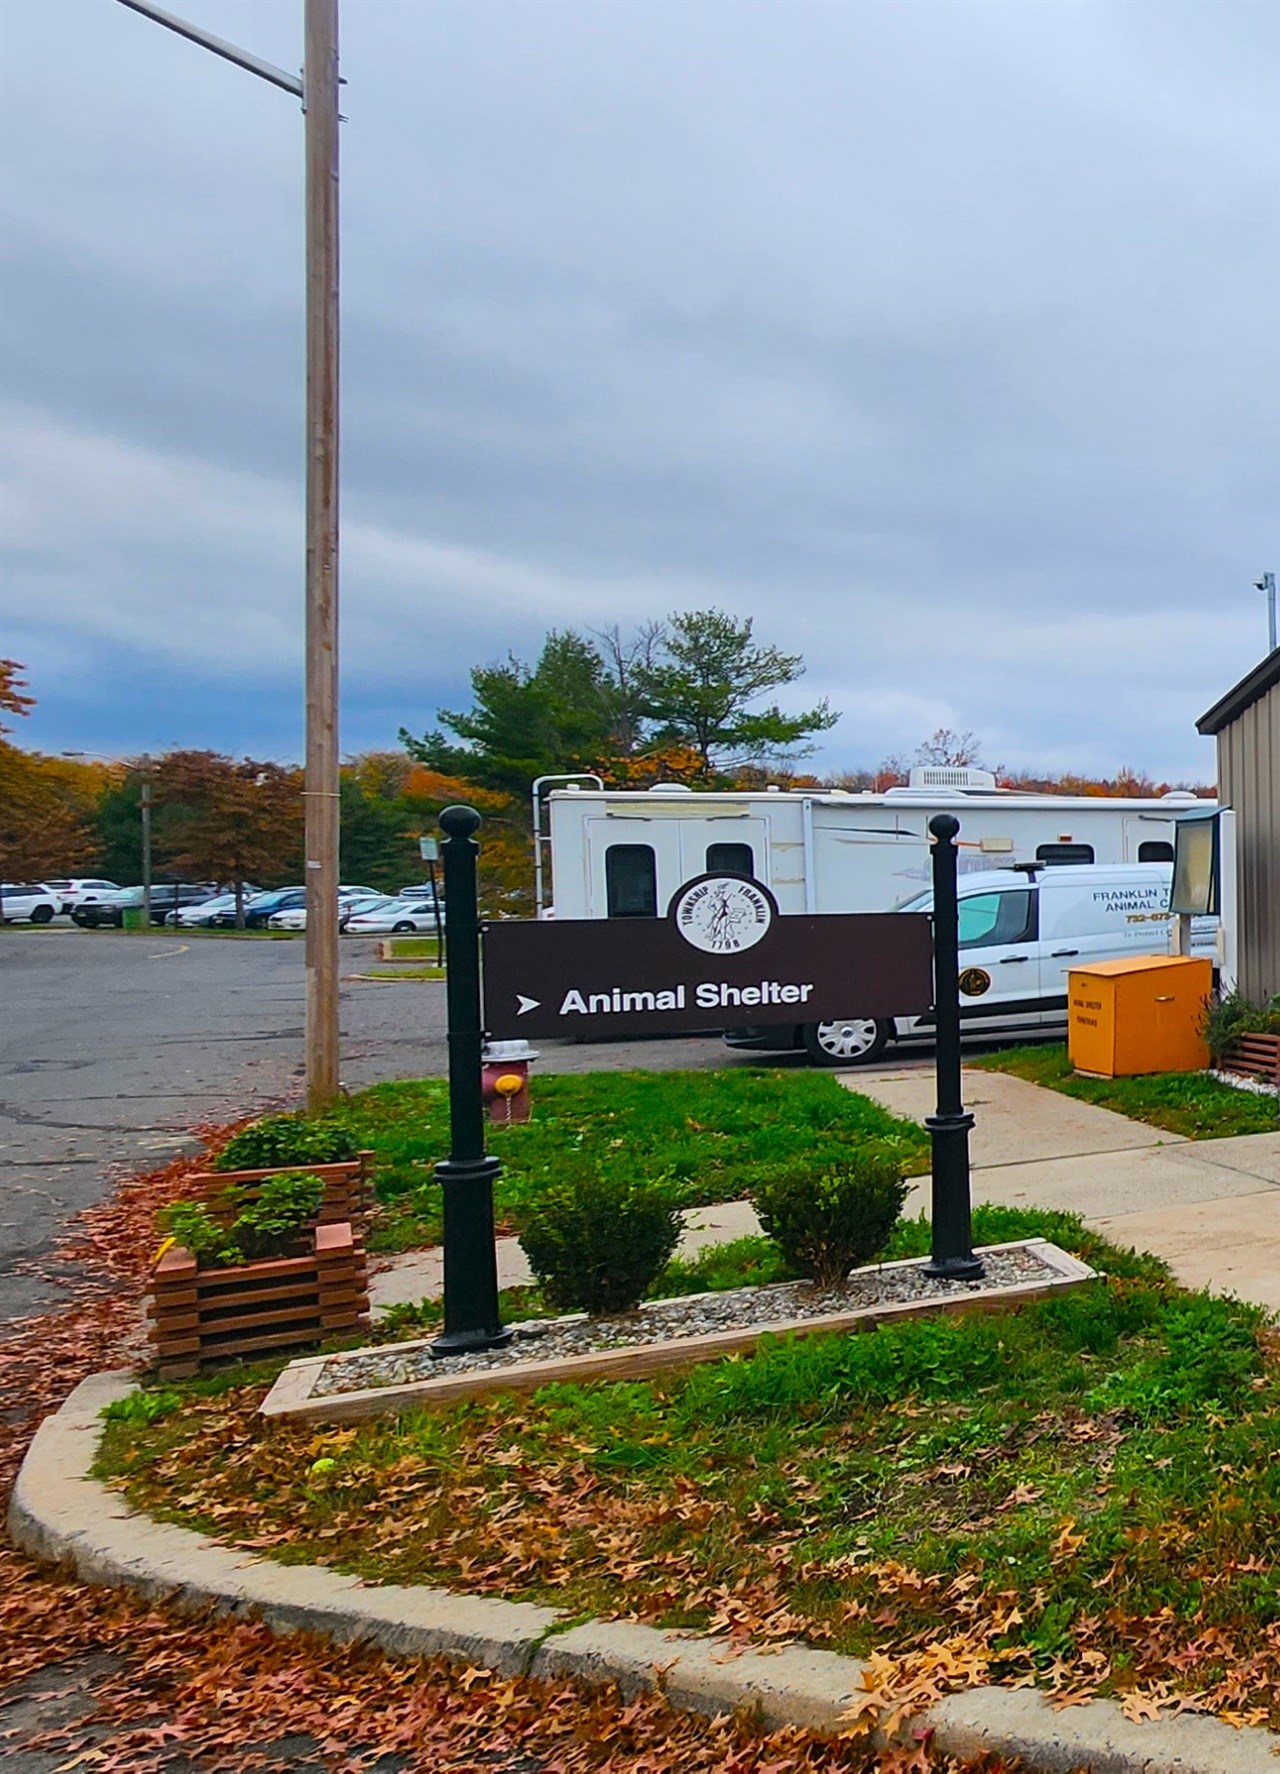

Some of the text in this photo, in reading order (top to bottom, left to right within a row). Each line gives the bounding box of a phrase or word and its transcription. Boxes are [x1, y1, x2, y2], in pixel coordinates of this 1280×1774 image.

[681, 886, 709, 926] TOWNSHIP
[737, 885, 766, 924] FRANKLIN
[1093, 888, 1157, 901] FRANKLIN
[1105, 901, 1155, 912] ANIMAL
[711, 939, 740, 950] 1798
[559, 981, 814, 1016] Animal Shelter
